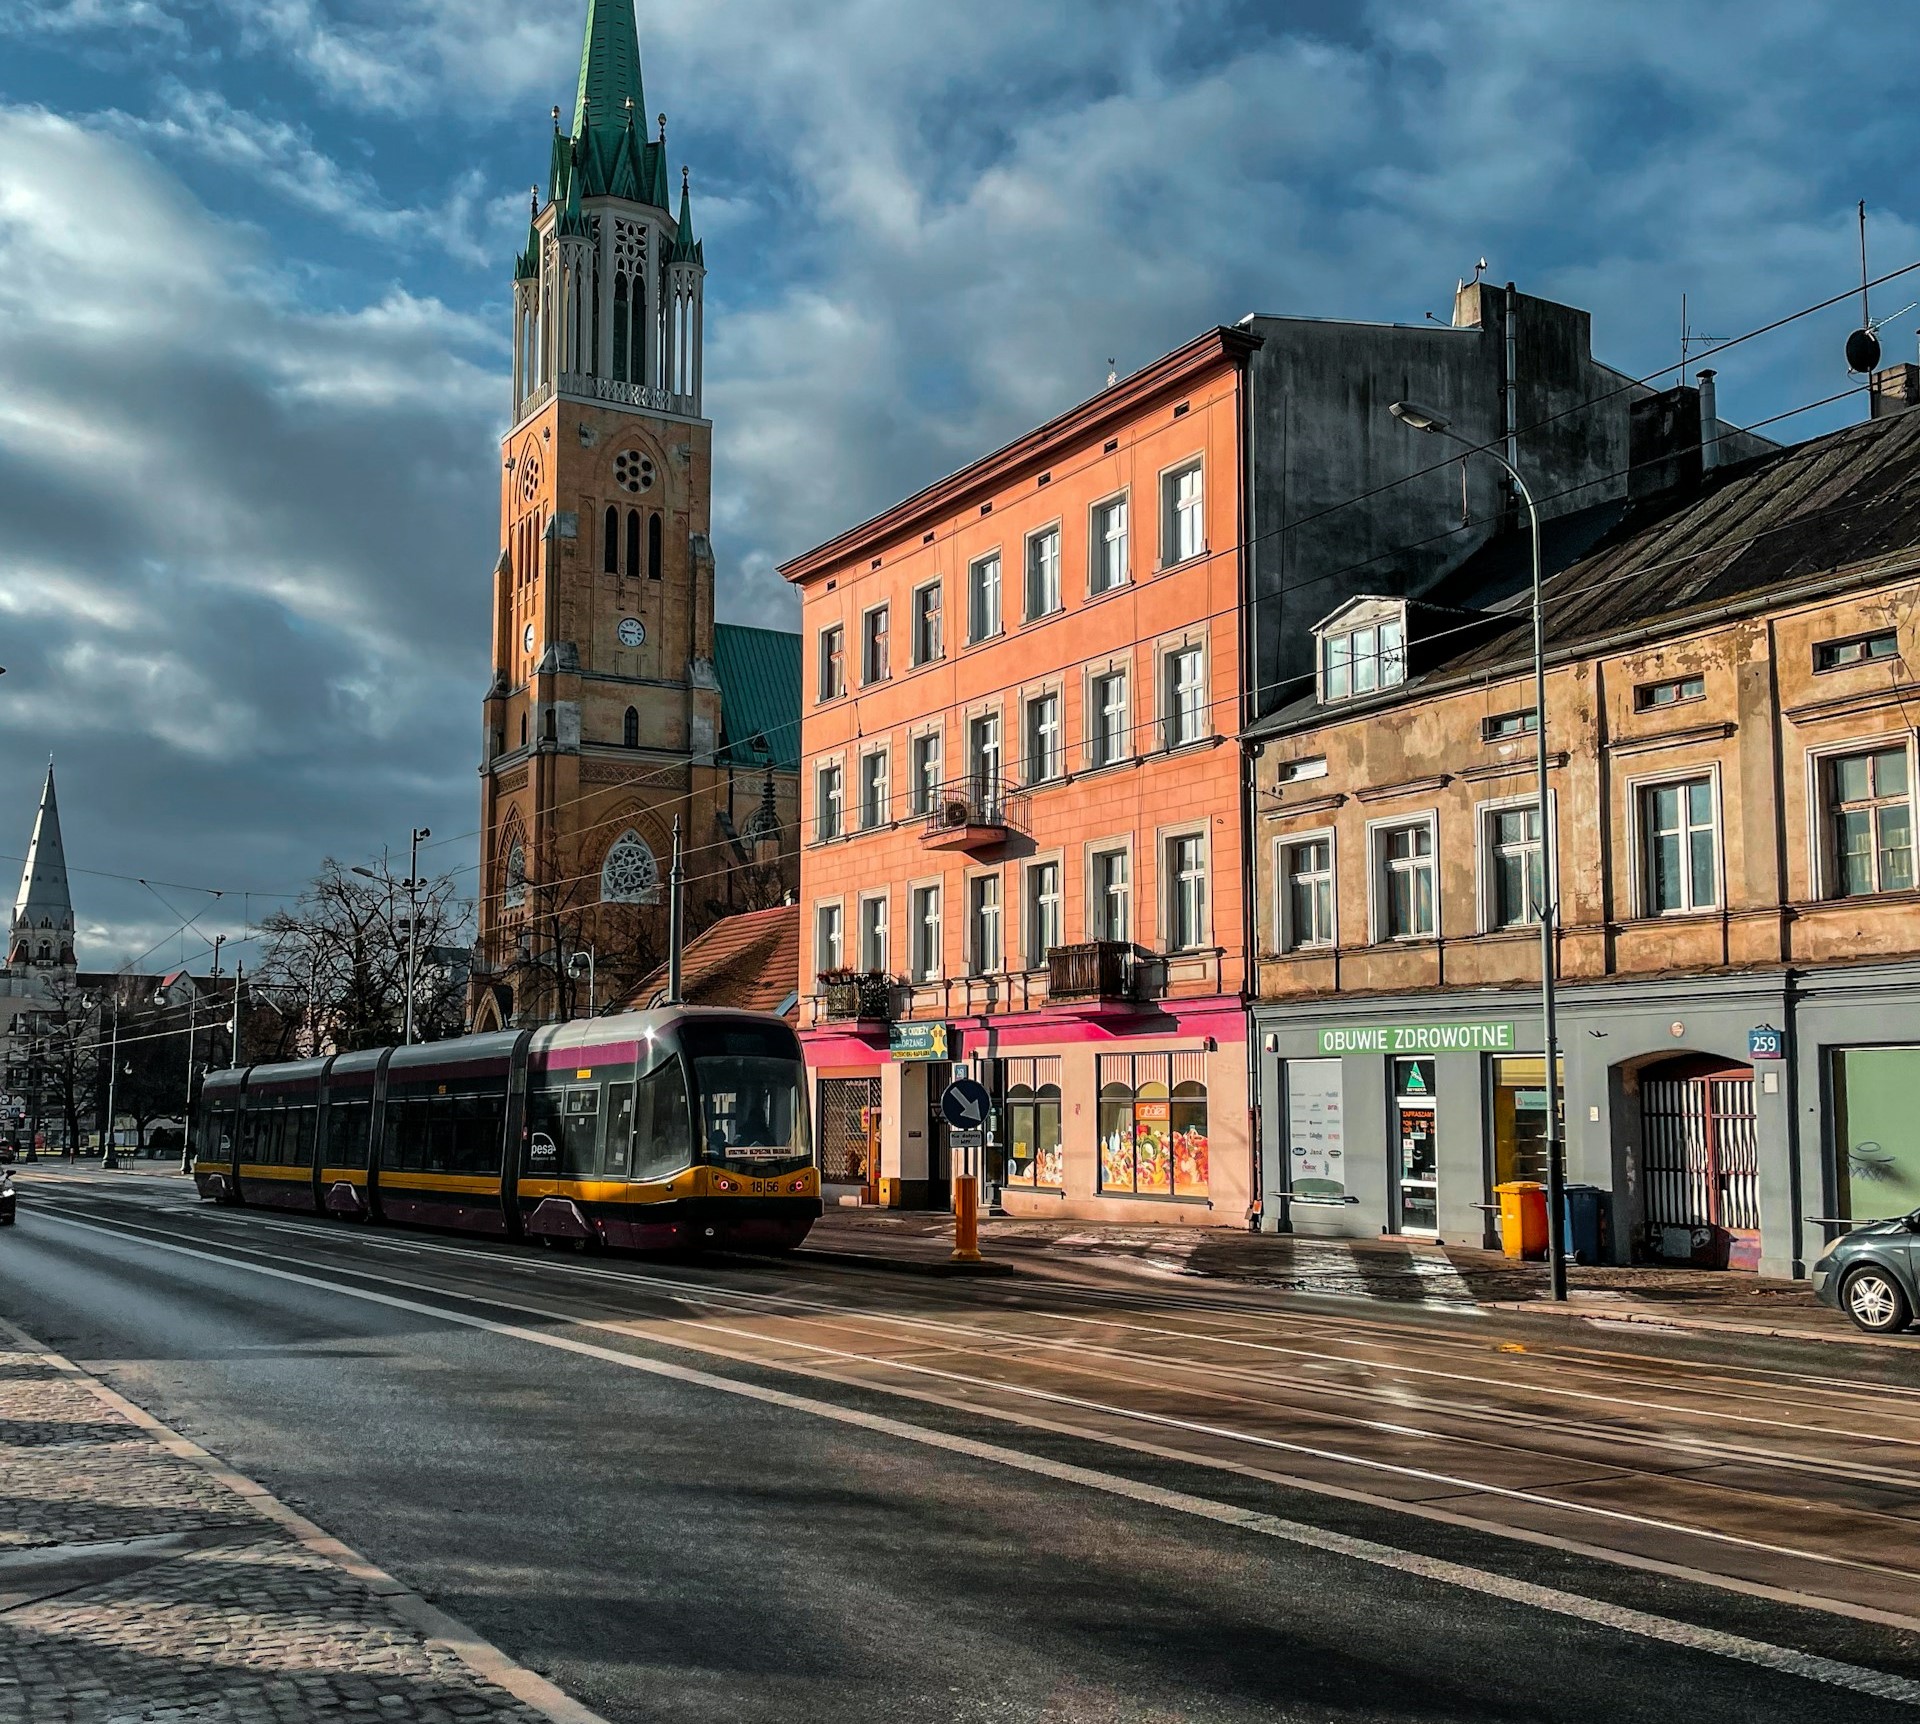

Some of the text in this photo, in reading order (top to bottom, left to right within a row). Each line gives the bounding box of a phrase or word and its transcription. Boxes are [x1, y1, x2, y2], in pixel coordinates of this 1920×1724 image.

[1323, 1025, 1509, 1051] OBUWIE ZDROWOTNE
[1753, 1036, 1776, 1052] 259
[531, 1144, 554, 1157] pesa
[750, 1181, 779, 1193] 1856
